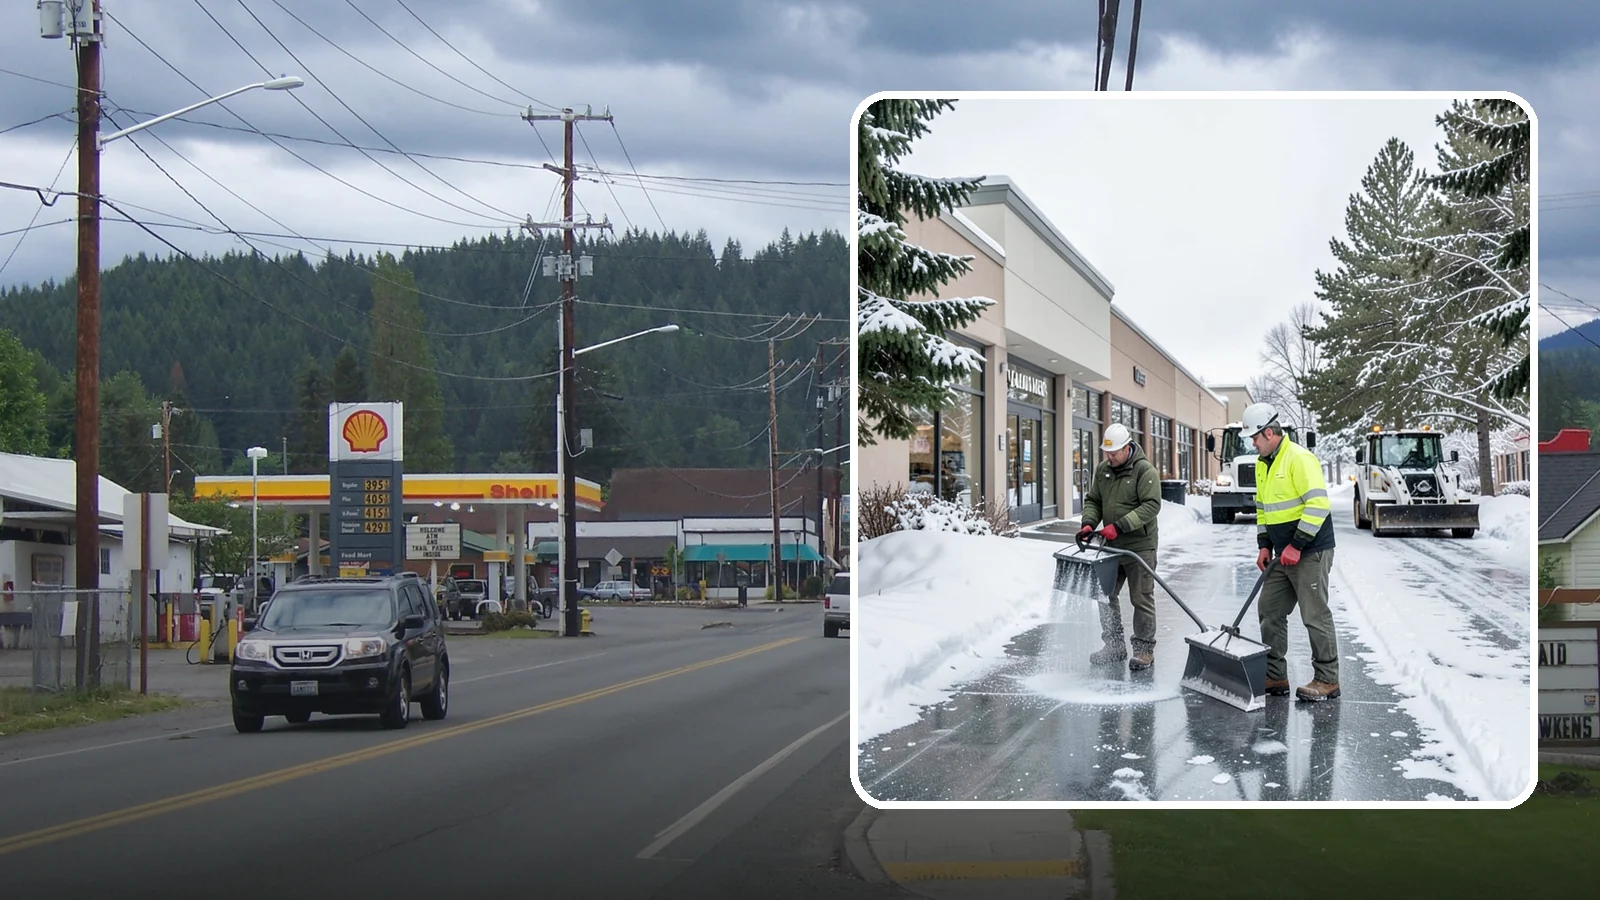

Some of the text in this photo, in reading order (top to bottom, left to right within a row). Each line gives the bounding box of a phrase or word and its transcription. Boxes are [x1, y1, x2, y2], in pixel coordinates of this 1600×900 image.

[365, 480, 384, 490] 395
[490, 484, 547, 499] Shell
[365, 494, 384, 504] 405
[365, 508, 384, 518] 415
[365, 522, 384, 533] 429
